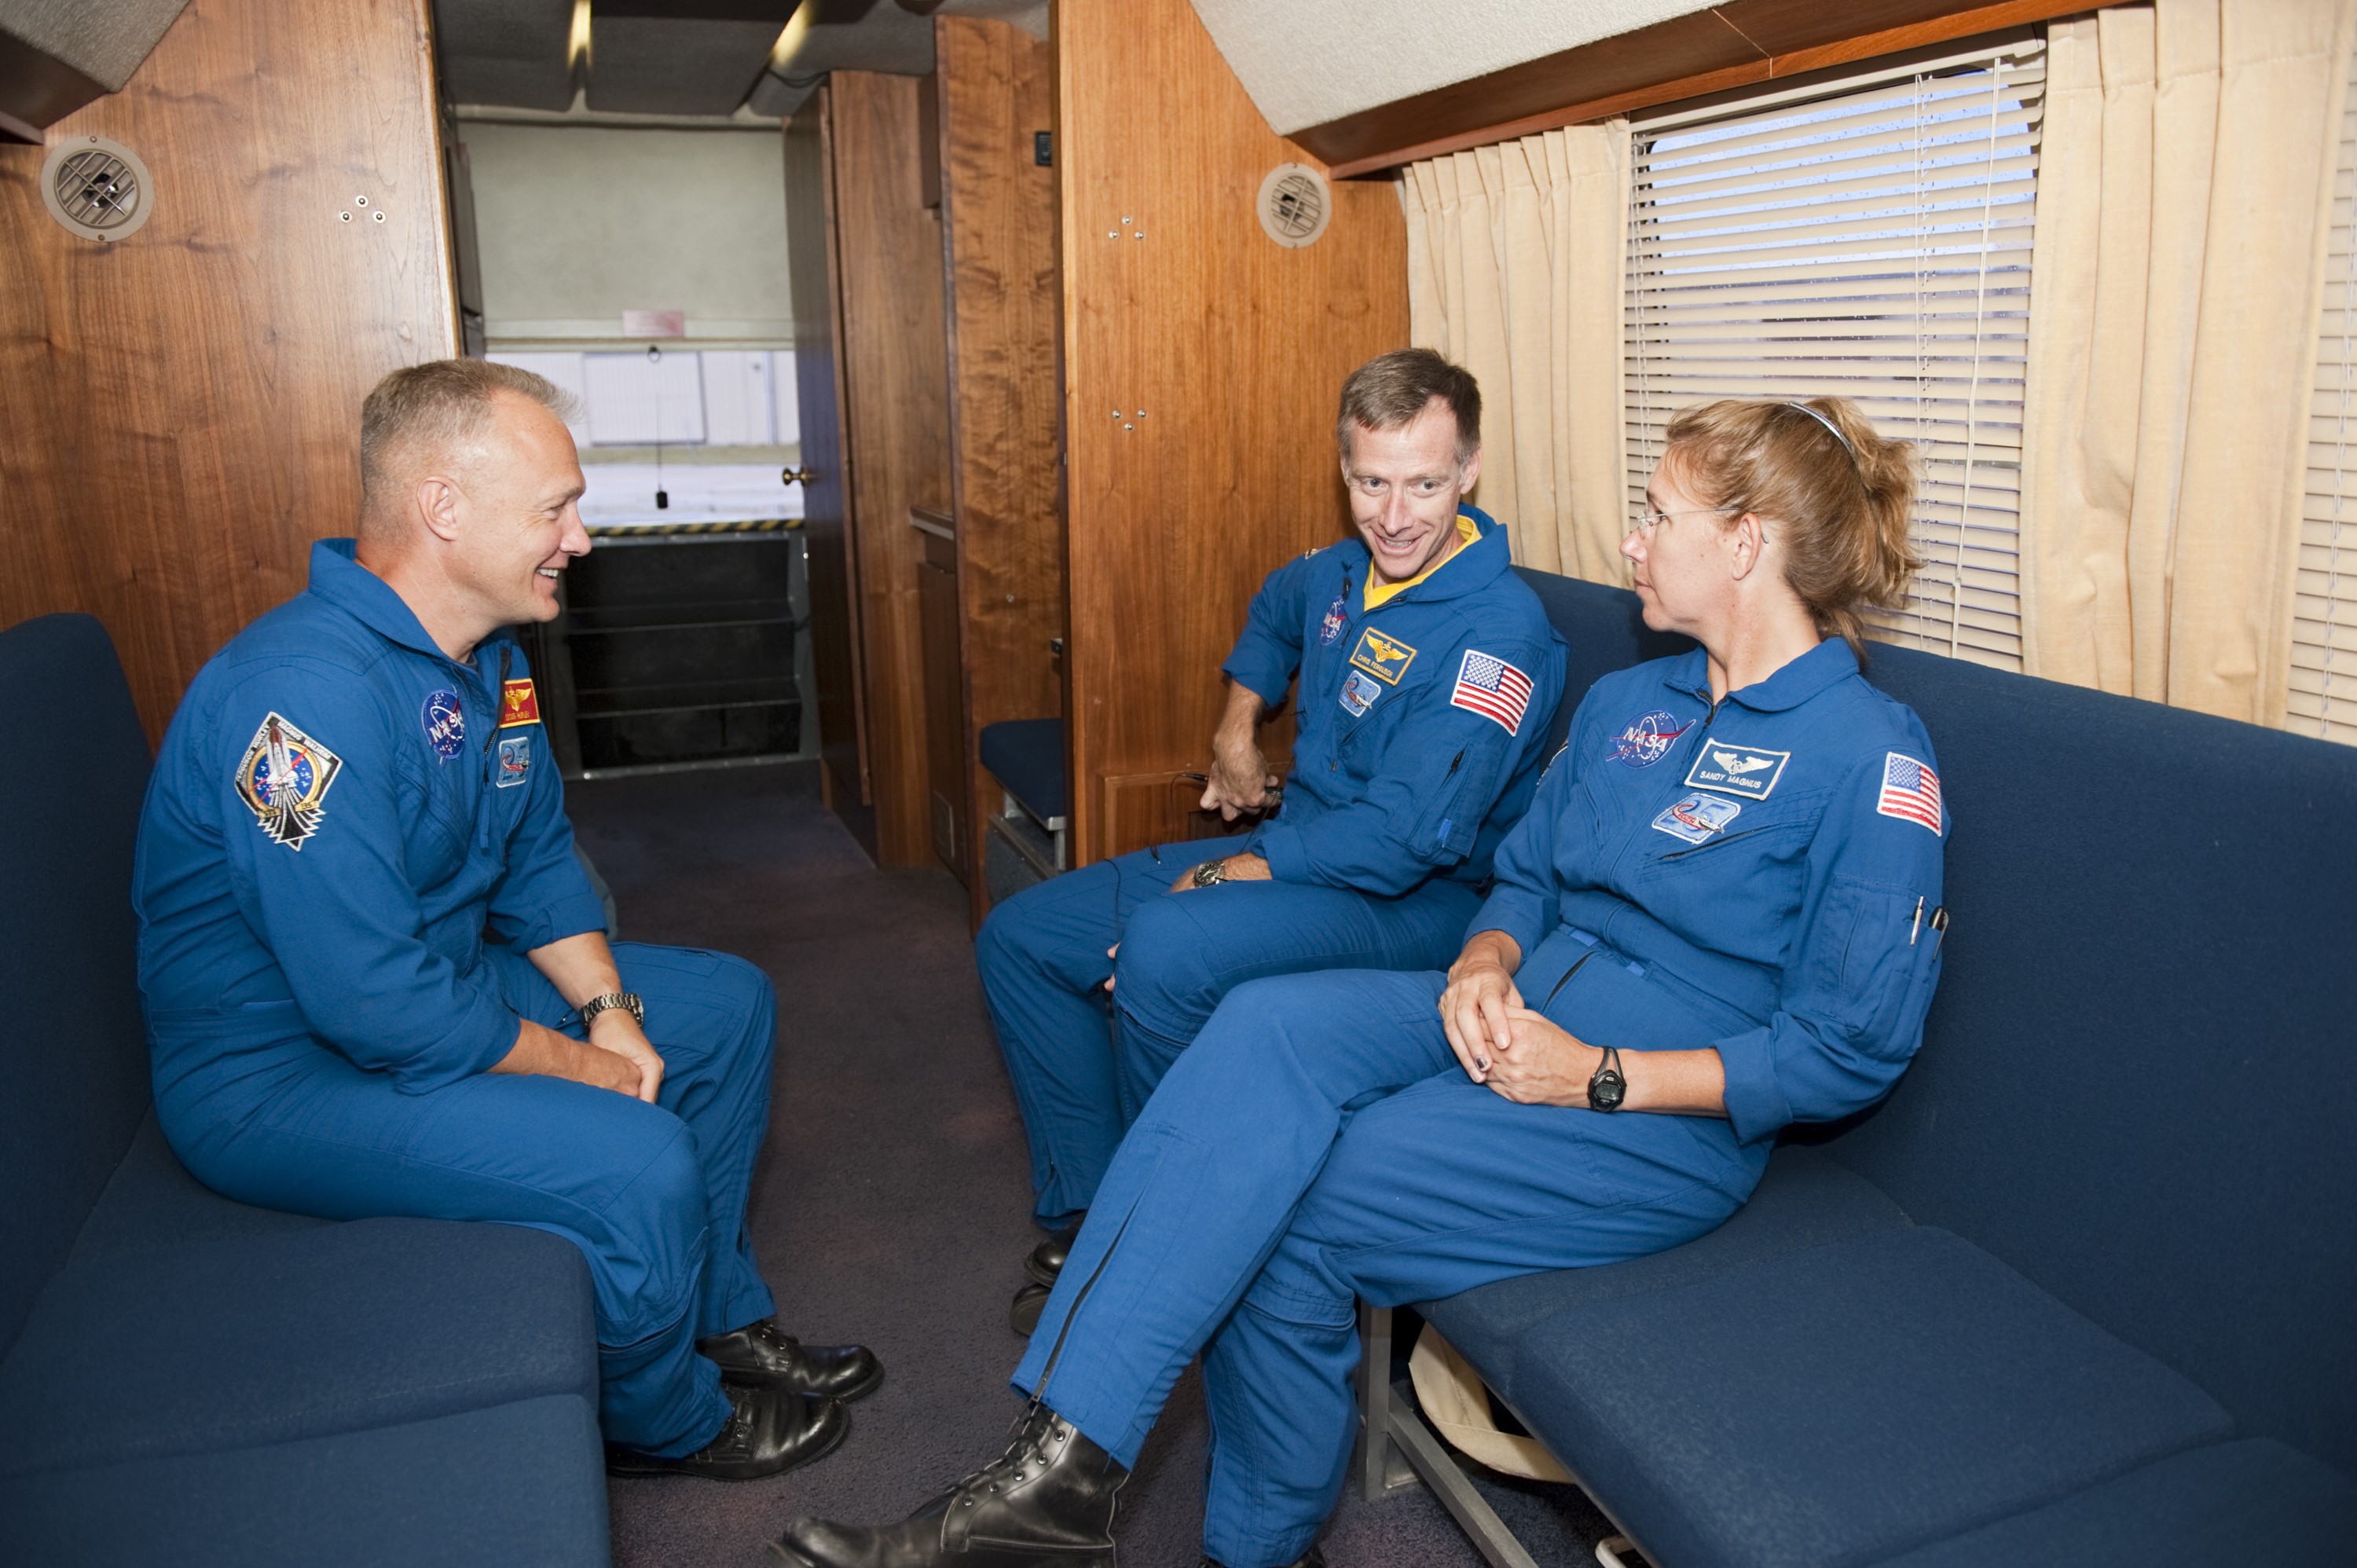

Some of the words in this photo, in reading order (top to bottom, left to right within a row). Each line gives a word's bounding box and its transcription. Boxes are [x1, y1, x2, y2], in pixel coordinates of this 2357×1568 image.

[1358, 654, 1371, 665] CHRIS
[277, 721, 303, 742] MAGNUS
[303, 739, 332, 760] WALHEIM
[1623, 727, 1669, 752] NASA
[1700, 770, 1725, 782] SANDY
[1726, 775, 1761, 789] MAGNUS
[1677, 813, 1695, 824] MACH
